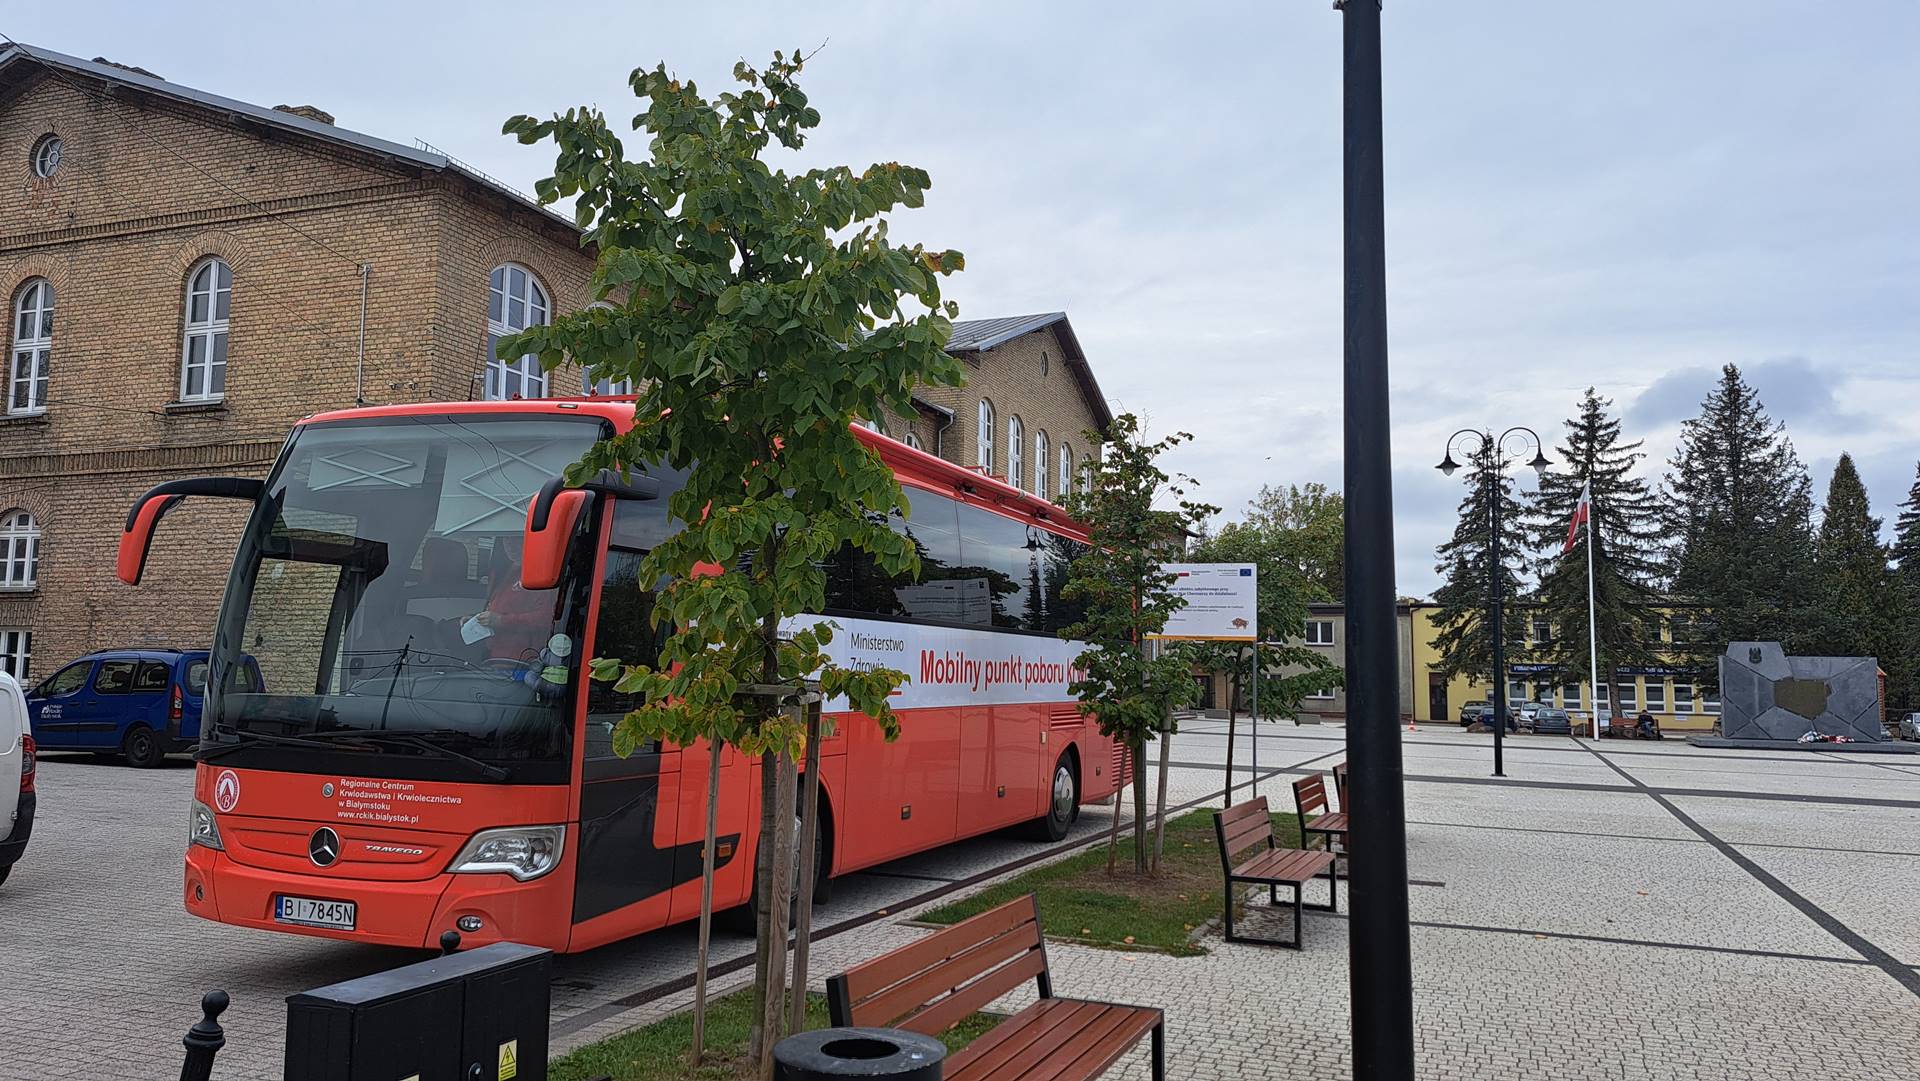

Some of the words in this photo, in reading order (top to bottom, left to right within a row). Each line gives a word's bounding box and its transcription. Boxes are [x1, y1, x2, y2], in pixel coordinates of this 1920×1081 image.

[850, 632, 904, 652] Ministerstwo
[920, 649, 981, 691] Mobilny
[985, 654, 1022, 691] punkt
[1025, 656, 1063, 690] poboru
[340, 778, 380, 789] Regionalne
[382, 781, 414, 791] Centrum
[339, 789, 391, 800] Krwiodawstwa
[397, 793, 462, 804] Krwiolecznictwa
[365, 844, 424, 856] TRAVEGO
[284, 899, 301, 918] BI
[309, 902, 353, 923] 7845N
